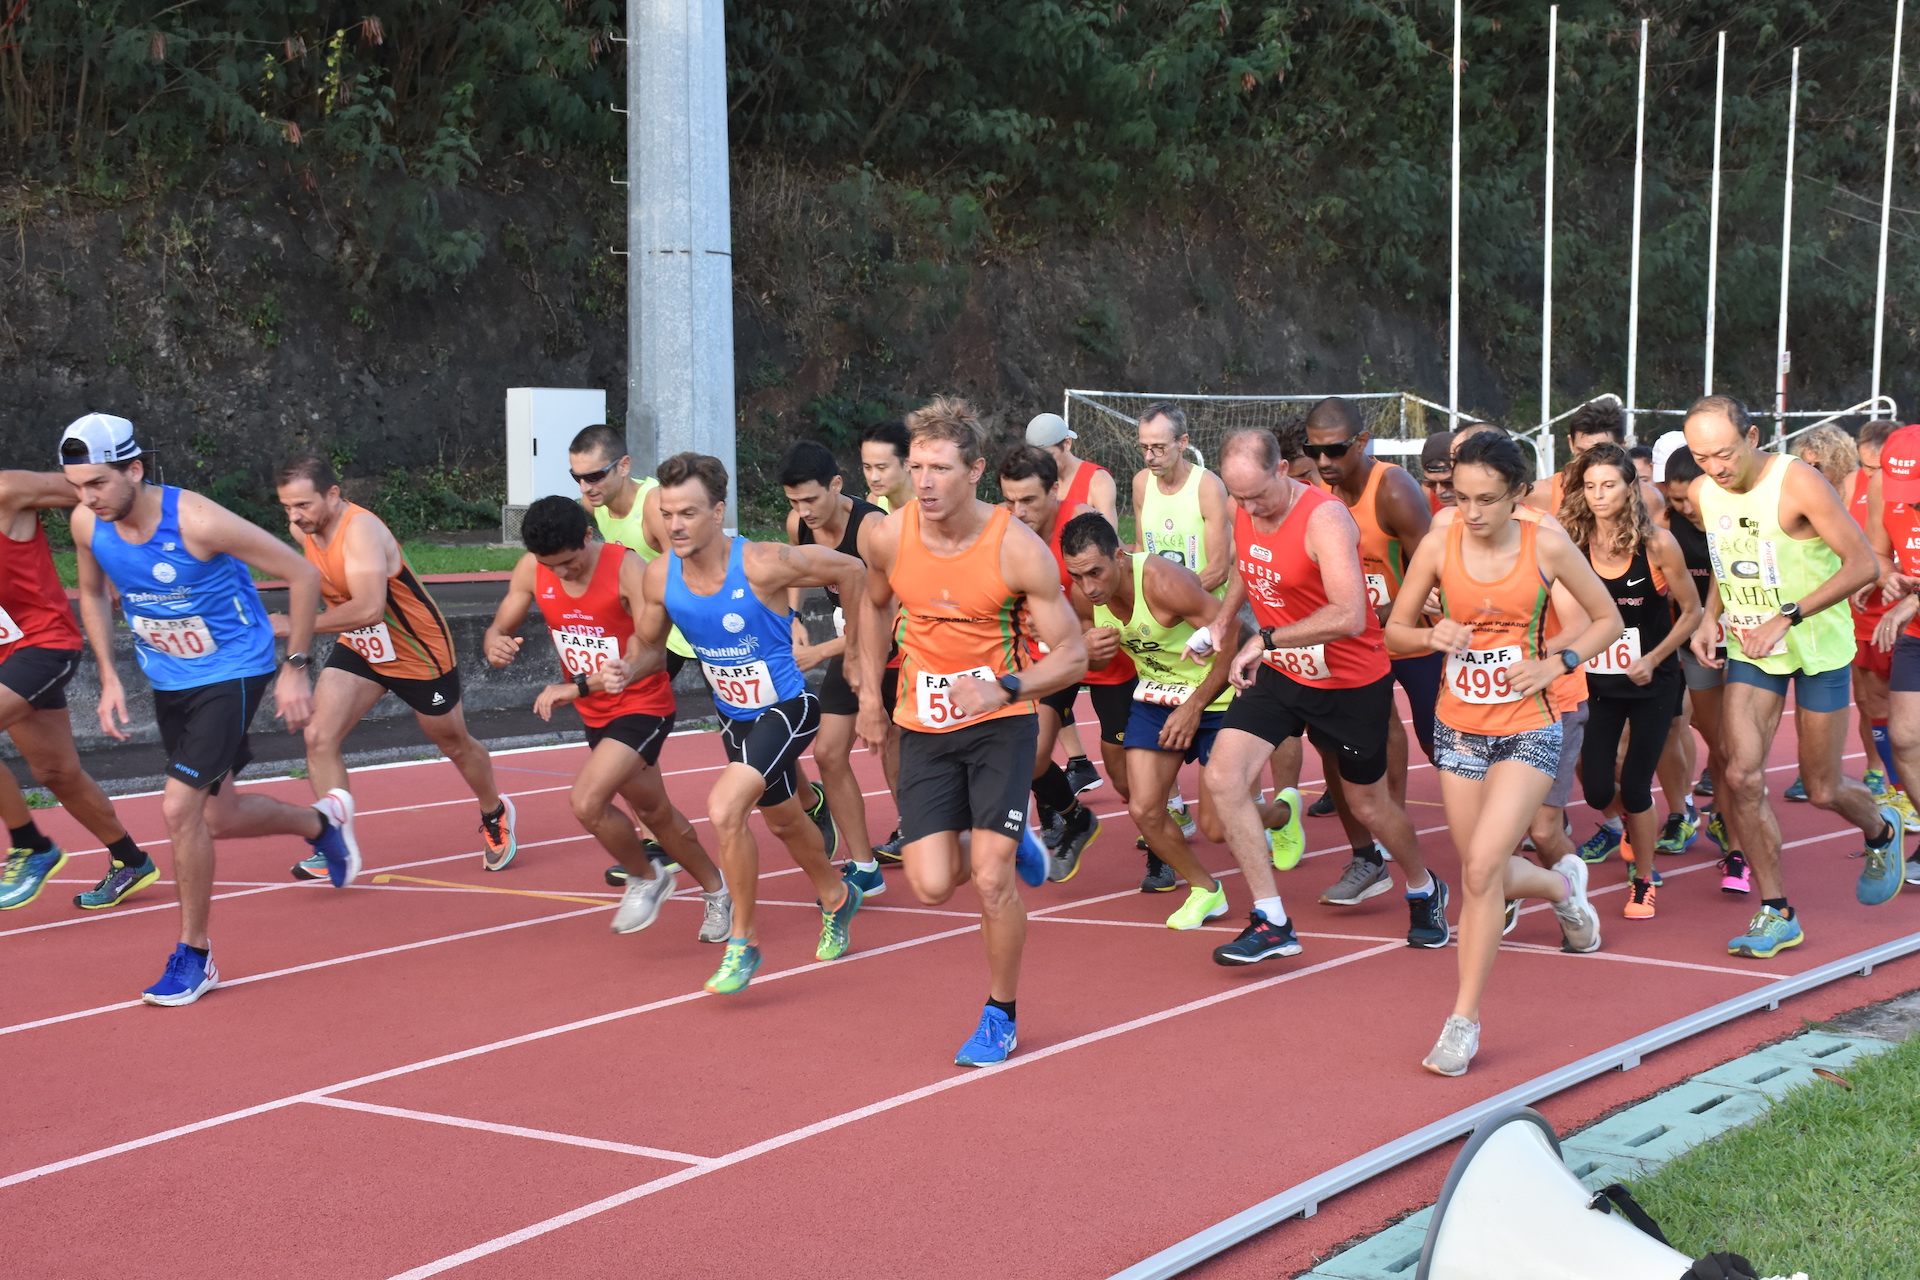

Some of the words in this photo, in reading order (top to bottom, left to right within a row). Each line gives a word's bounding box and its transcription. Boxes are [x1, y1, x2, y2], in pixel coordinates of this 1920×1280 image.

[1239, 560, 1282, 583] ASCEP
[1765, 548, 1777, 586] INTERSPORT
[560, 634, 609, 650] F.A.P.F.
[561, 624, 606, 637] ASCEP
[149, 631, 205, 655] 510
[708, 665, 759, 678] F.A.P.F.
[1270, 651, 1319, 676] 583
[716, 678, 761, 704] 597
[1145, 681, 1187, 695] F.A.P.F.
[1455, 665, 1513, 698] 499
